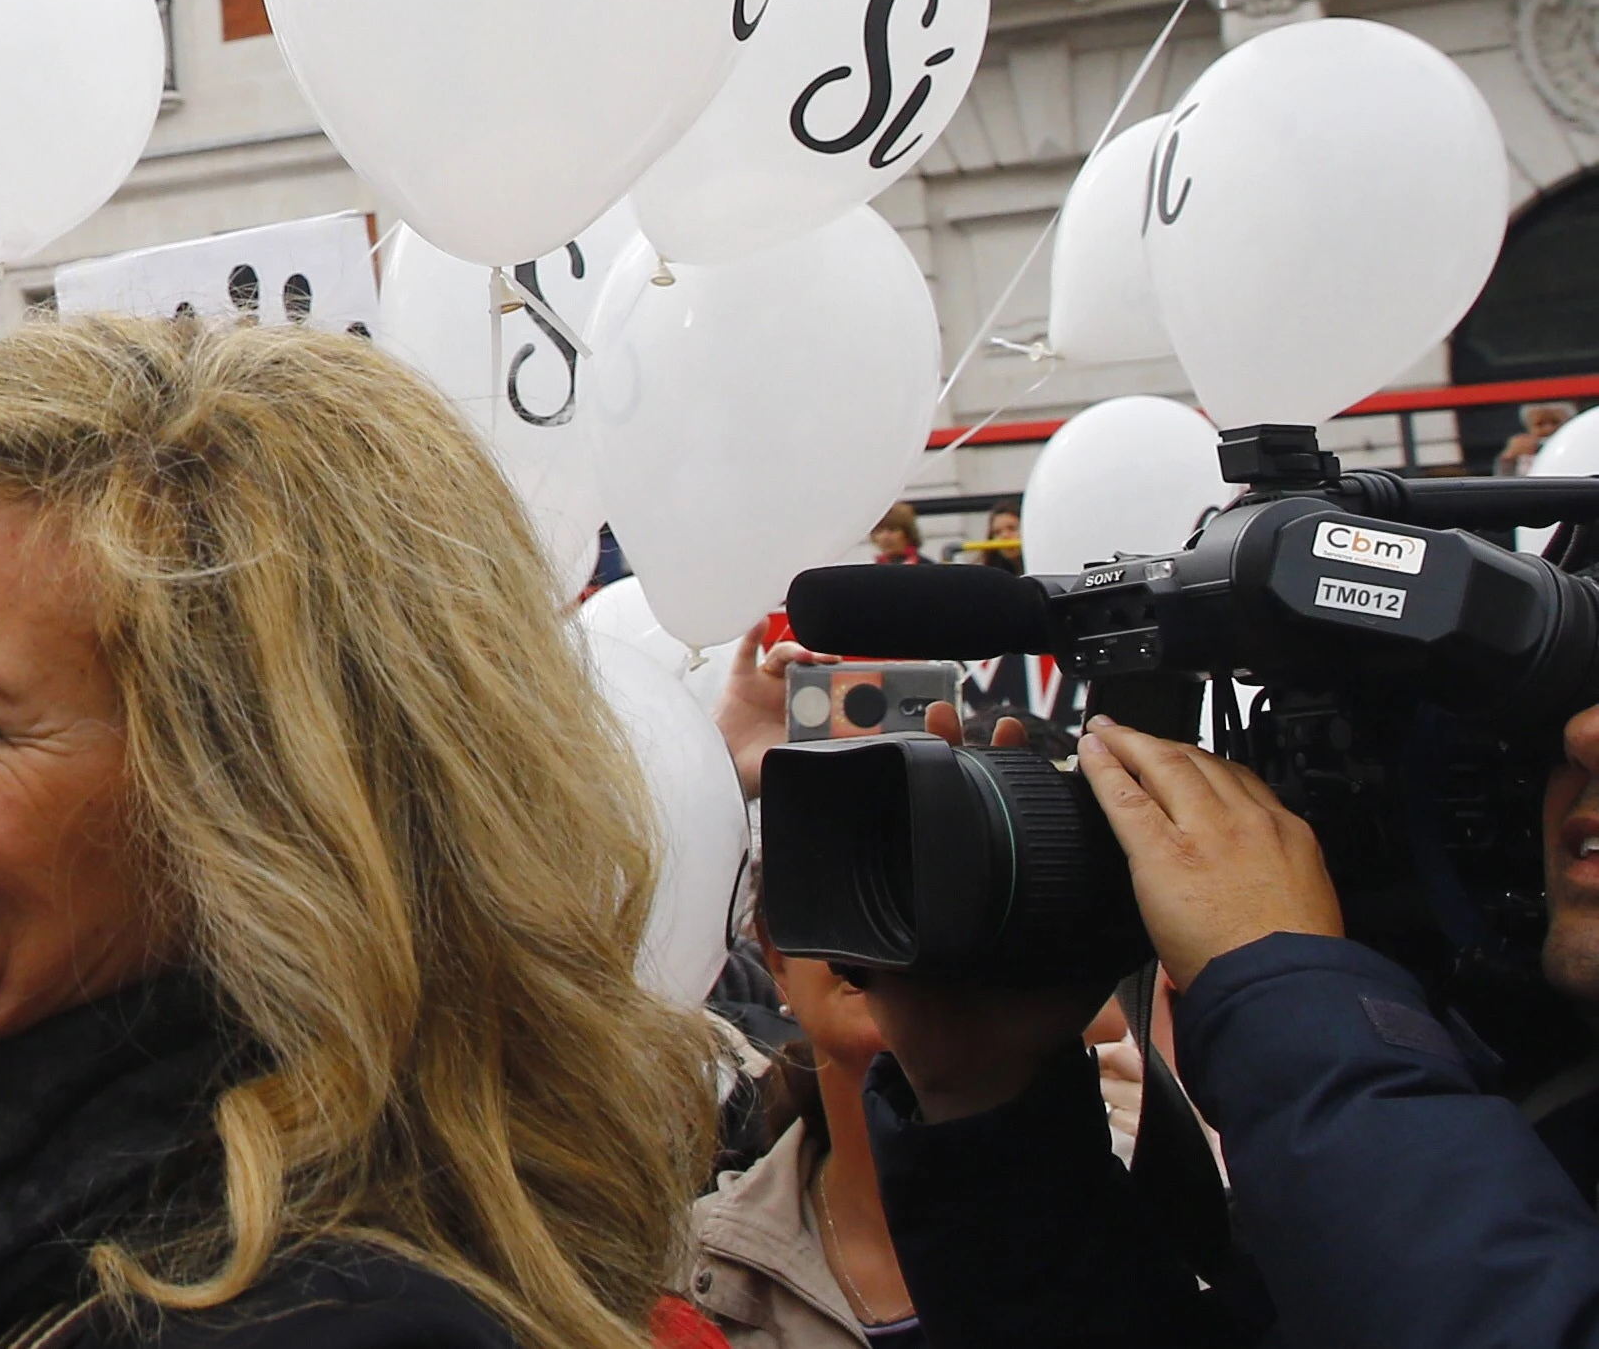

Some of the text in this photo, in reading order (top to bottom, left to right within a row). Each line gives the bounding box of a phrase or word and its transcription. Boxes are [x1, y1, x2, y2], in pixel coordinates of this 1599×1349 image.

[1327, 527, 1404, 559] Cbm
[1084, 570, 1125, 587] SONY
[1322, 583, 1400, 612] TM012
